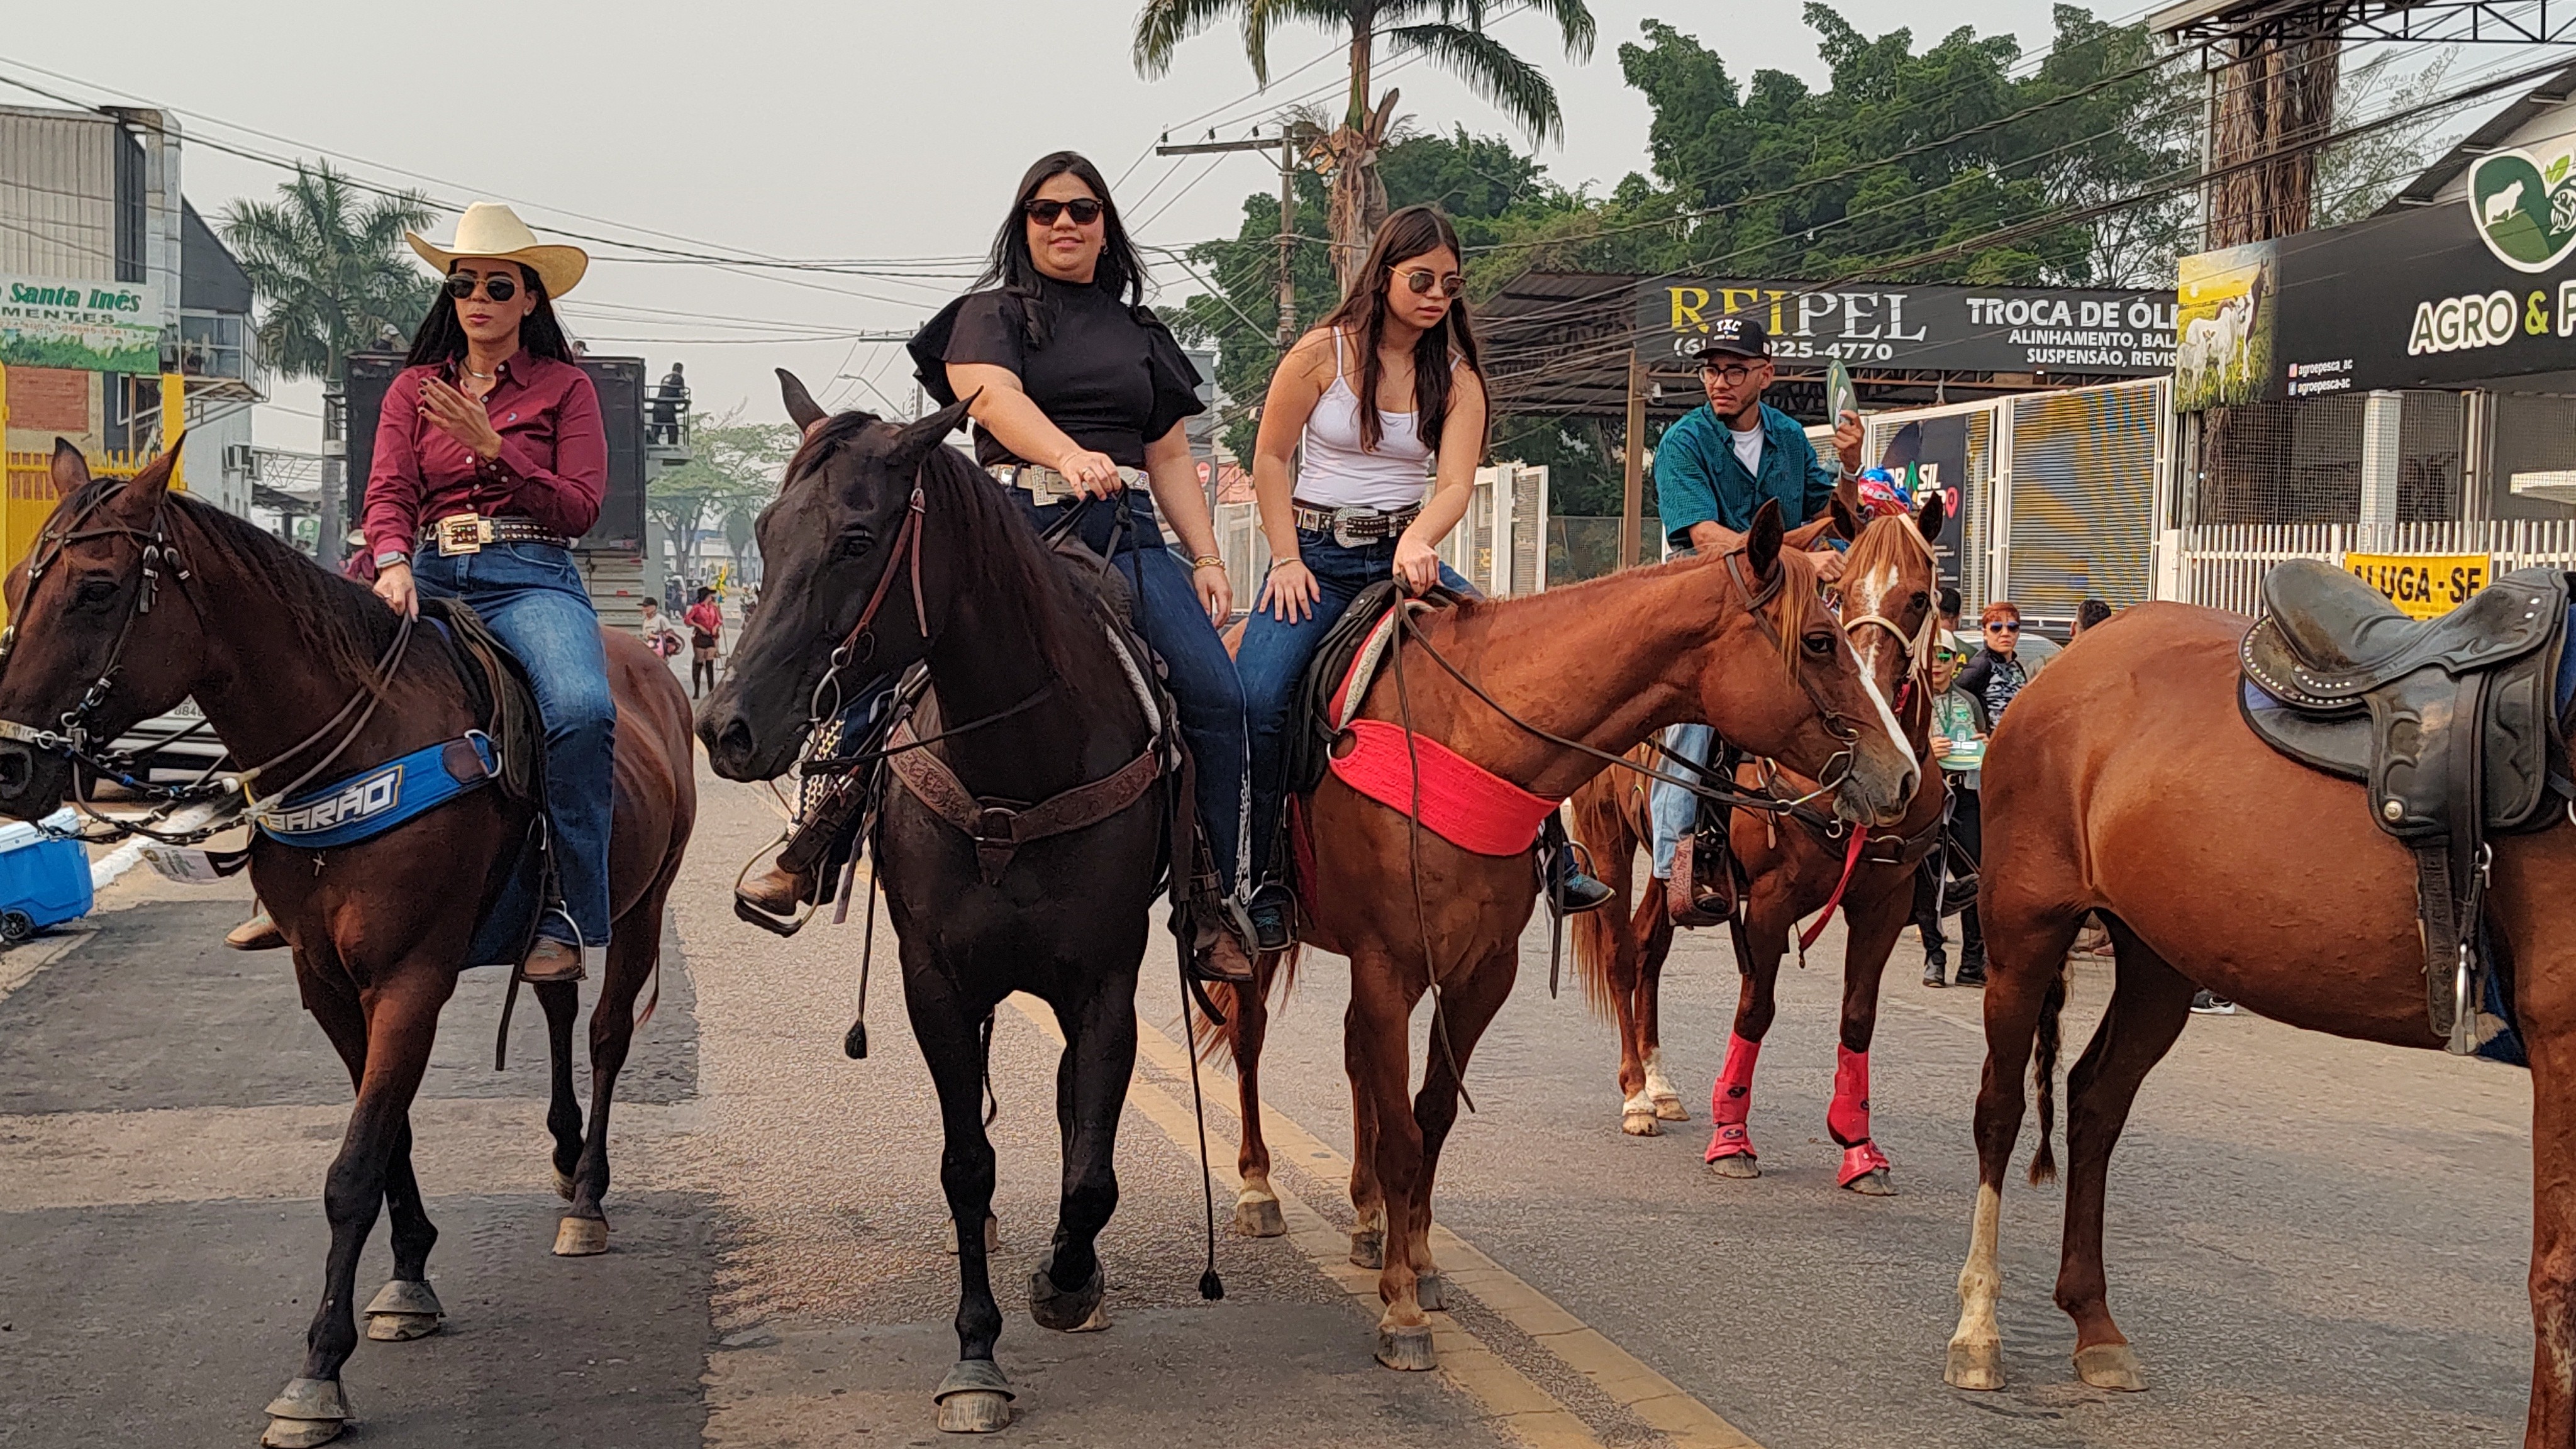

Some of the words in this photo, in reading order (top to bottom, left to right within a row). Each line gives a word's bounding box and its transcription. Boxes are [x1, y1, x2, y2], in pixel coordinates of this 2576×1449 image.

[9, 282, 80, 308] Santa
[87, 289, 142, 313] Inês
[1967, 298, 2073, 327] TROCA
[2080, 301, 2120, 328] DE
[2407, 290, 2518, 356] AGRO
[2524, 290, 2549, 335] &
[2008, 330, 2138, 349] ALINHAMENTO,
[2027, 347, 2127, 367] SUSPENSÃO,
[268, 772, 396, 831] BARÃO
